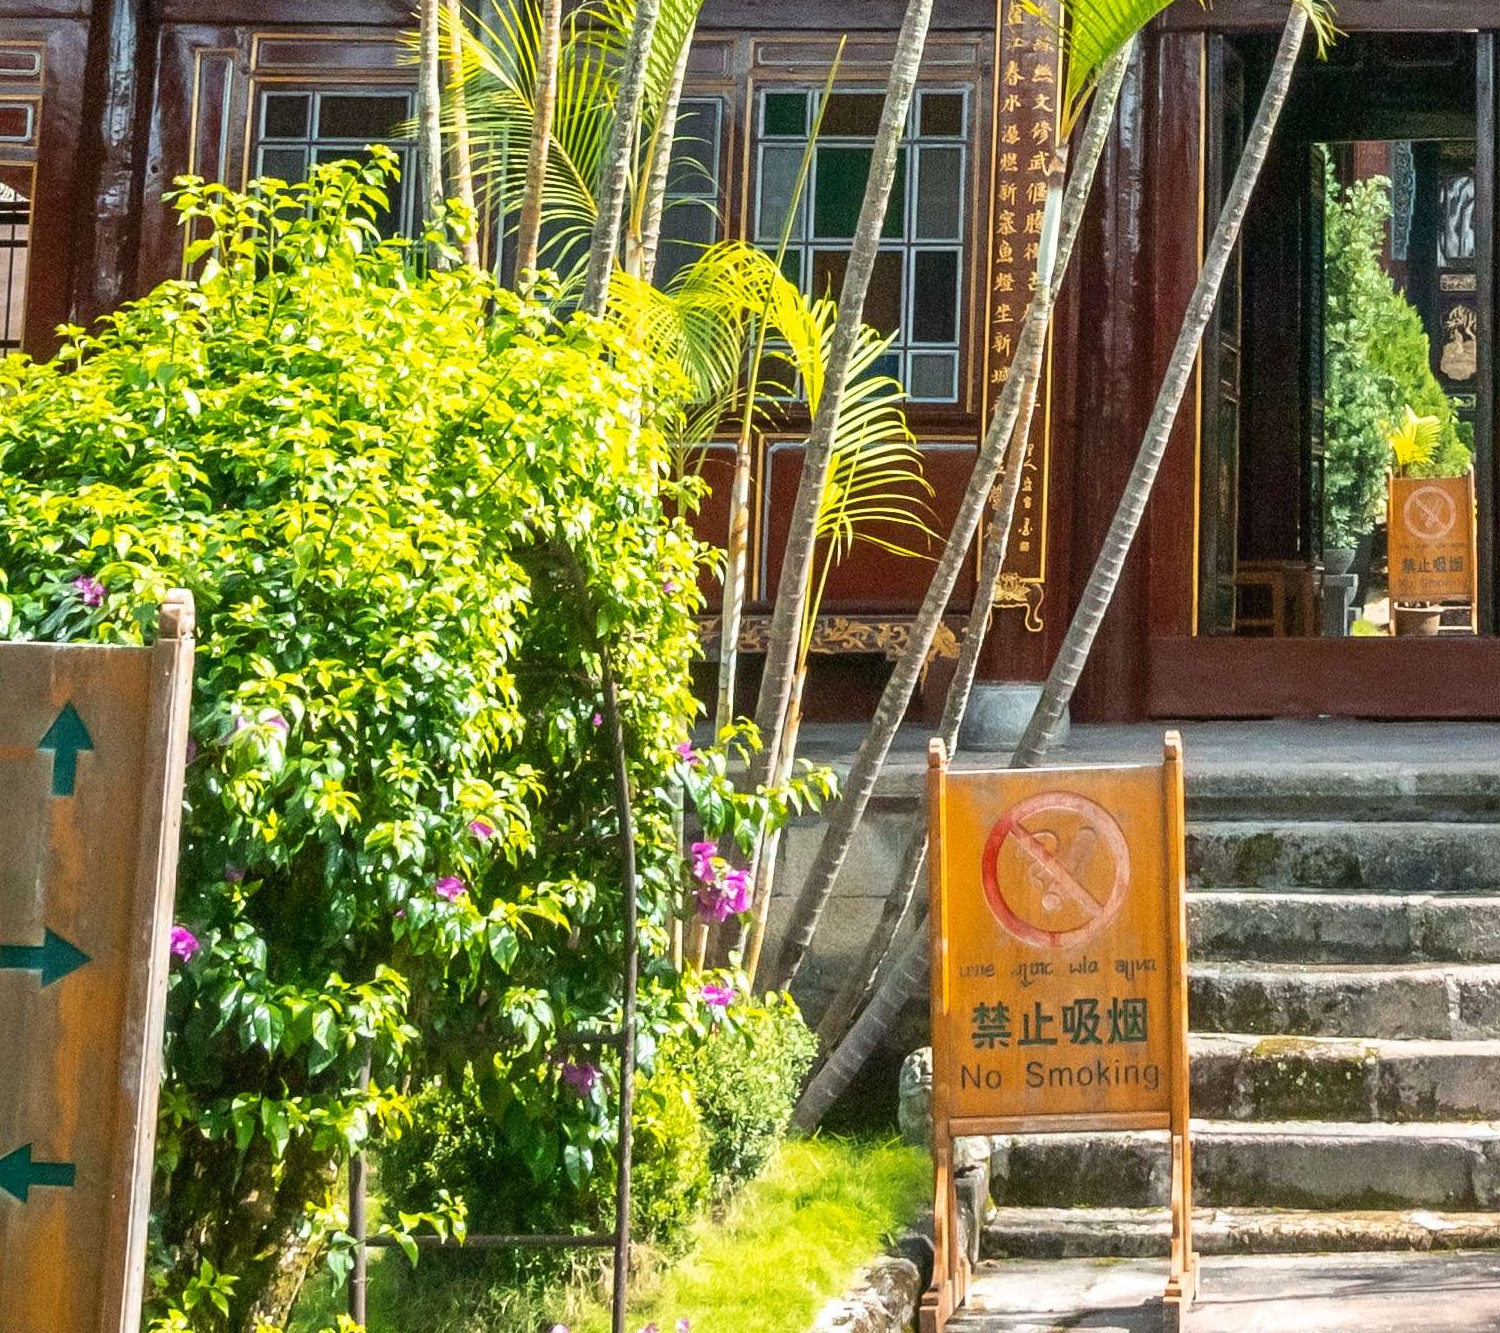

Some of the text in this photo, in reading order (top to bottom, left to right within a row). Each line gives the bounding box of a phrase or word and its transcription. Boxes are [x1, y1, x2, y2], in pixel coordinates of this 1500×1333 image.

[970, 997, 1149, 1050] 禁止吸烟
[960, 1060, 1160, 1091] No Smoking
